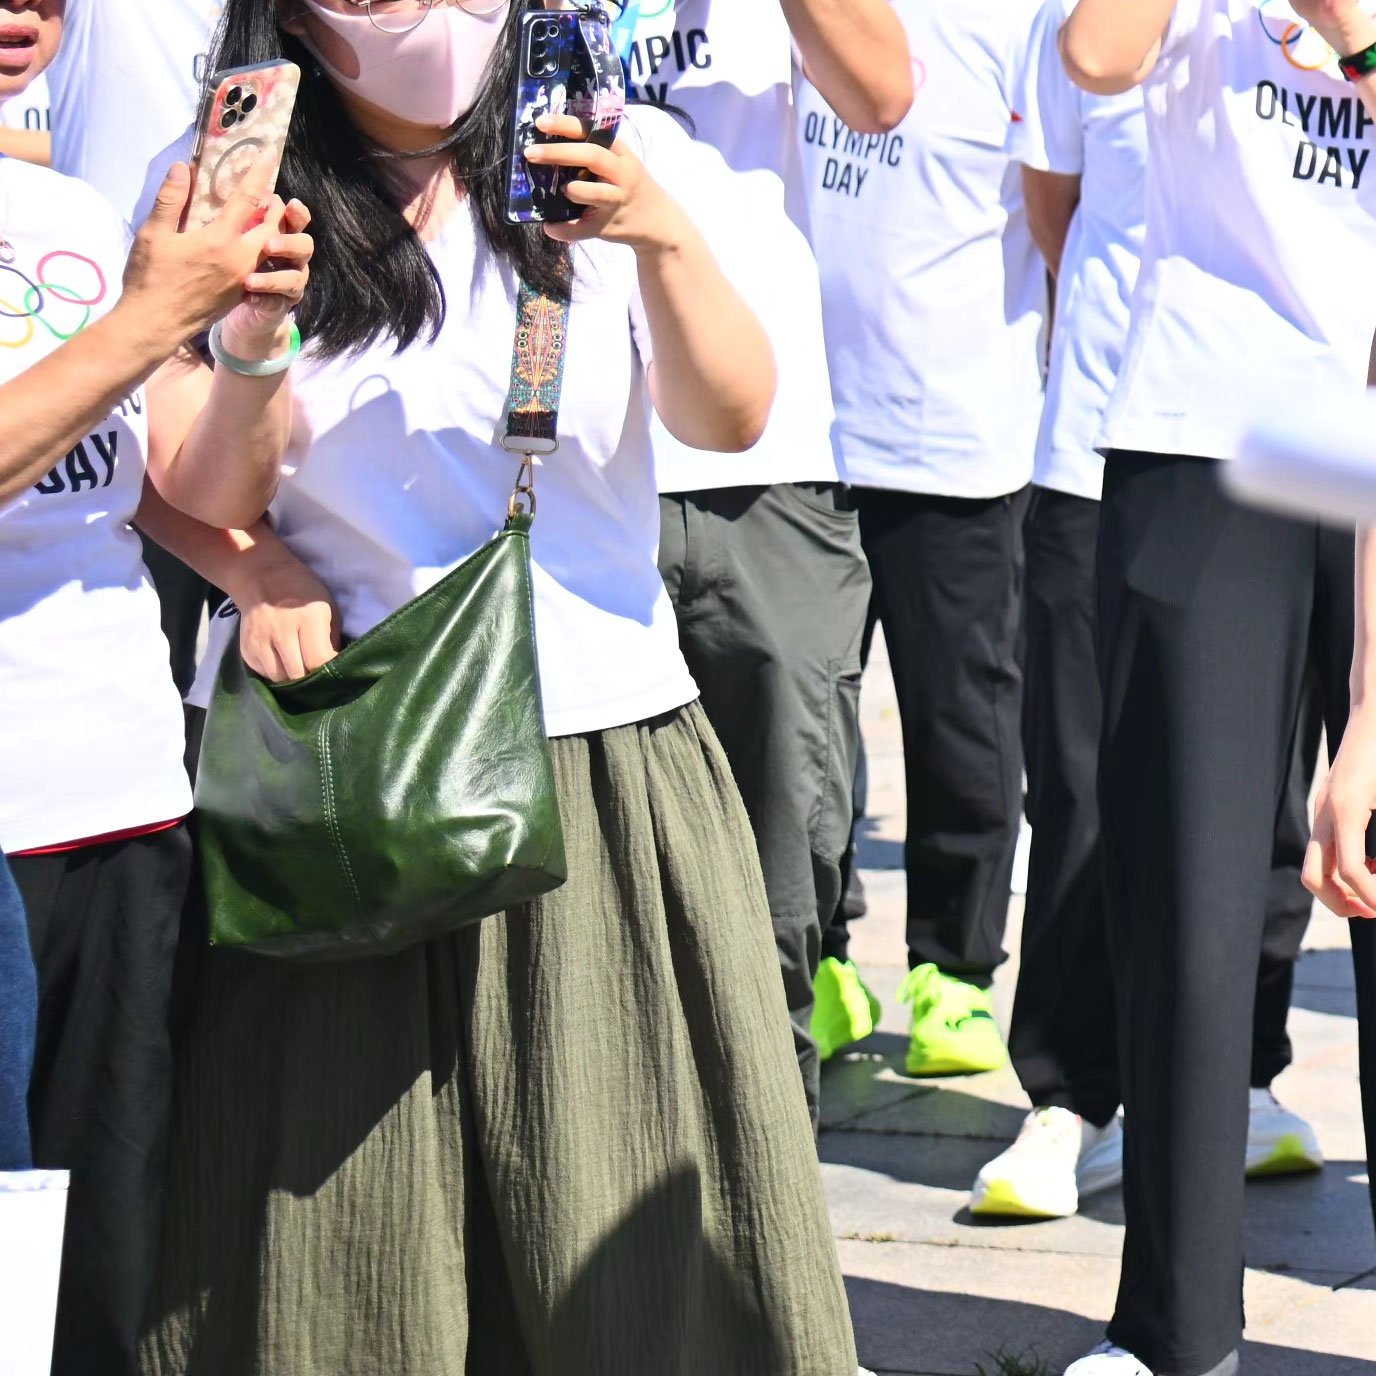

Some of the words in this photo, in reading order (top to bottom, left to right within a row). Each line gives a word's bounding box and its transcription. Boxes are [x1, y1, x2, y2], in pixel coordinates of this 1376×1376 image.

[1255, 79, 1375, 140] OLYMP
[804, 111, 904, 167] OLYMPIC
[1292, 140, 1371, 190] DAY
[822, 157, 869, 199] DAY
